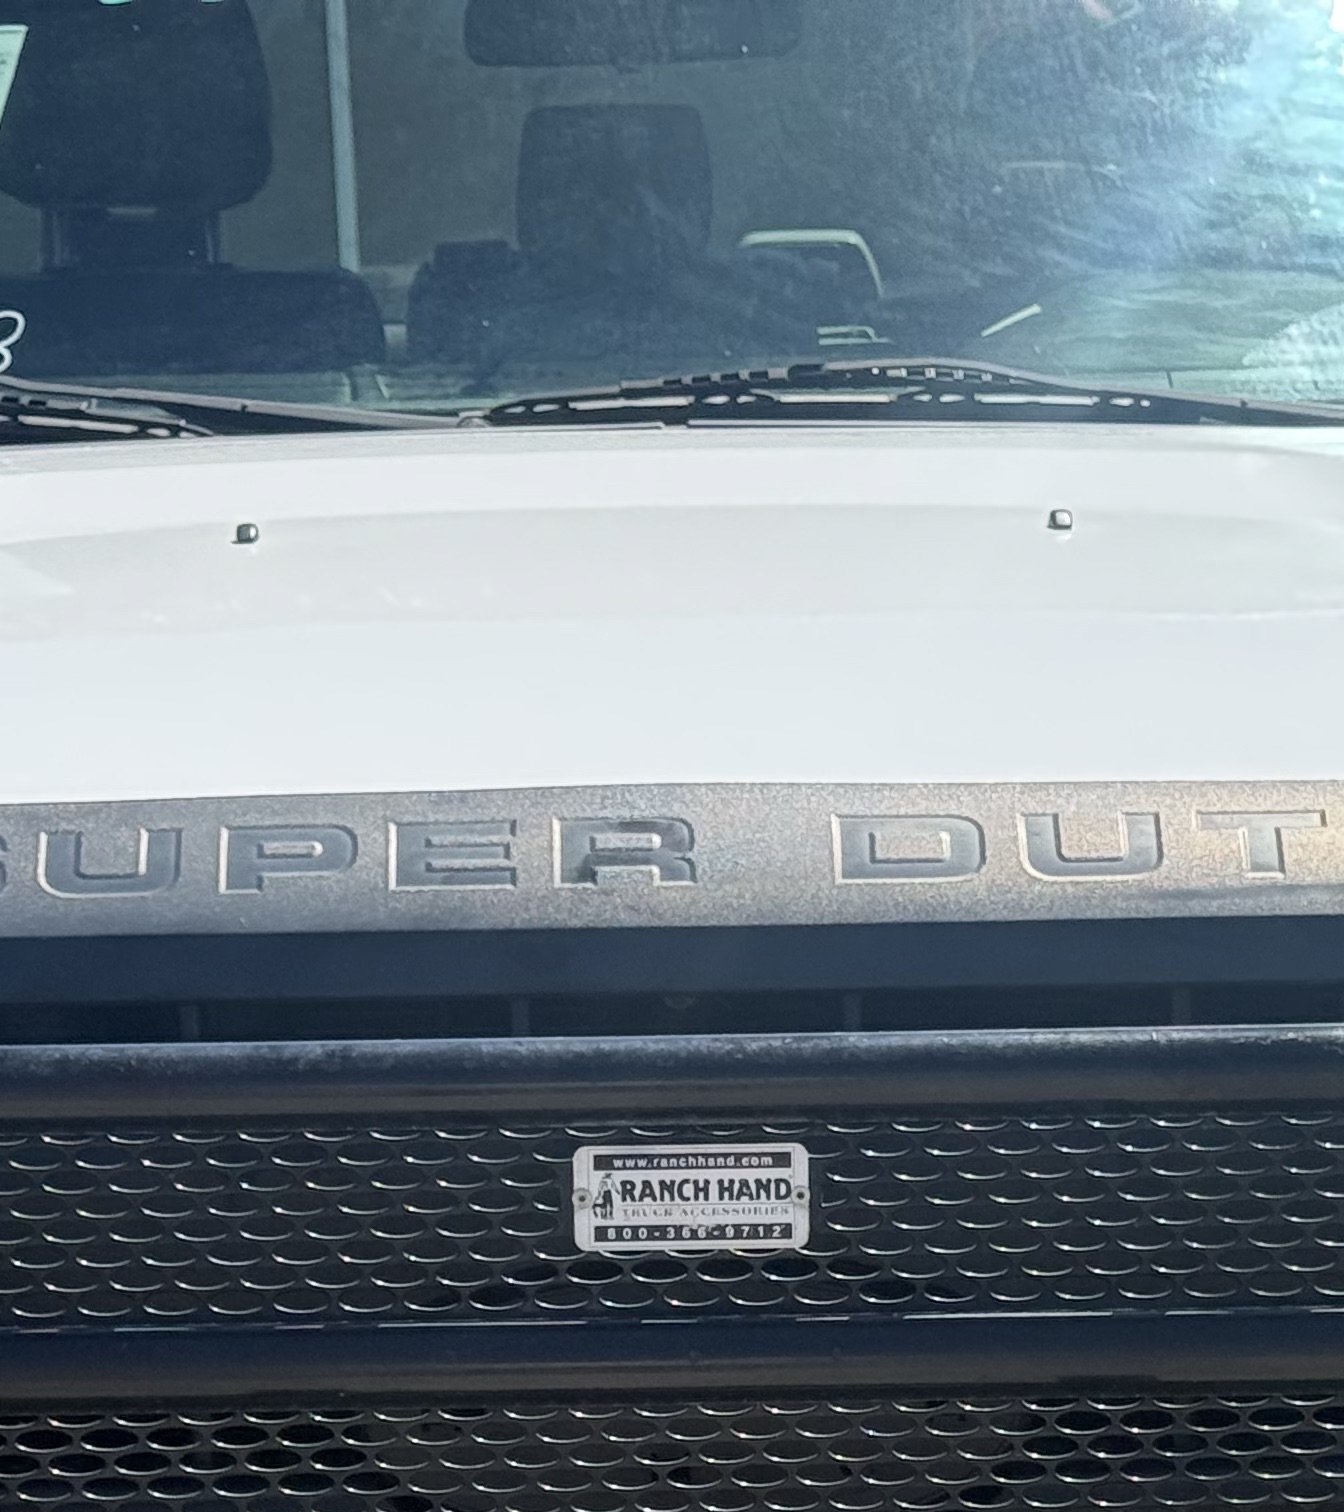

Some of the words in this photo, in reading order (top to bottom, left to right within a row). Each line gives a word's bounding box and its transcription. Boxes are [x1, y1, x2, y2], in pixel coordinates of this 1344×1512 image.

[612, 1155, 773, 1168] www.ranchhand.com
[619, 1178, 711, 1203] RANCH
[717, 1177, 792, 1202] HAND
